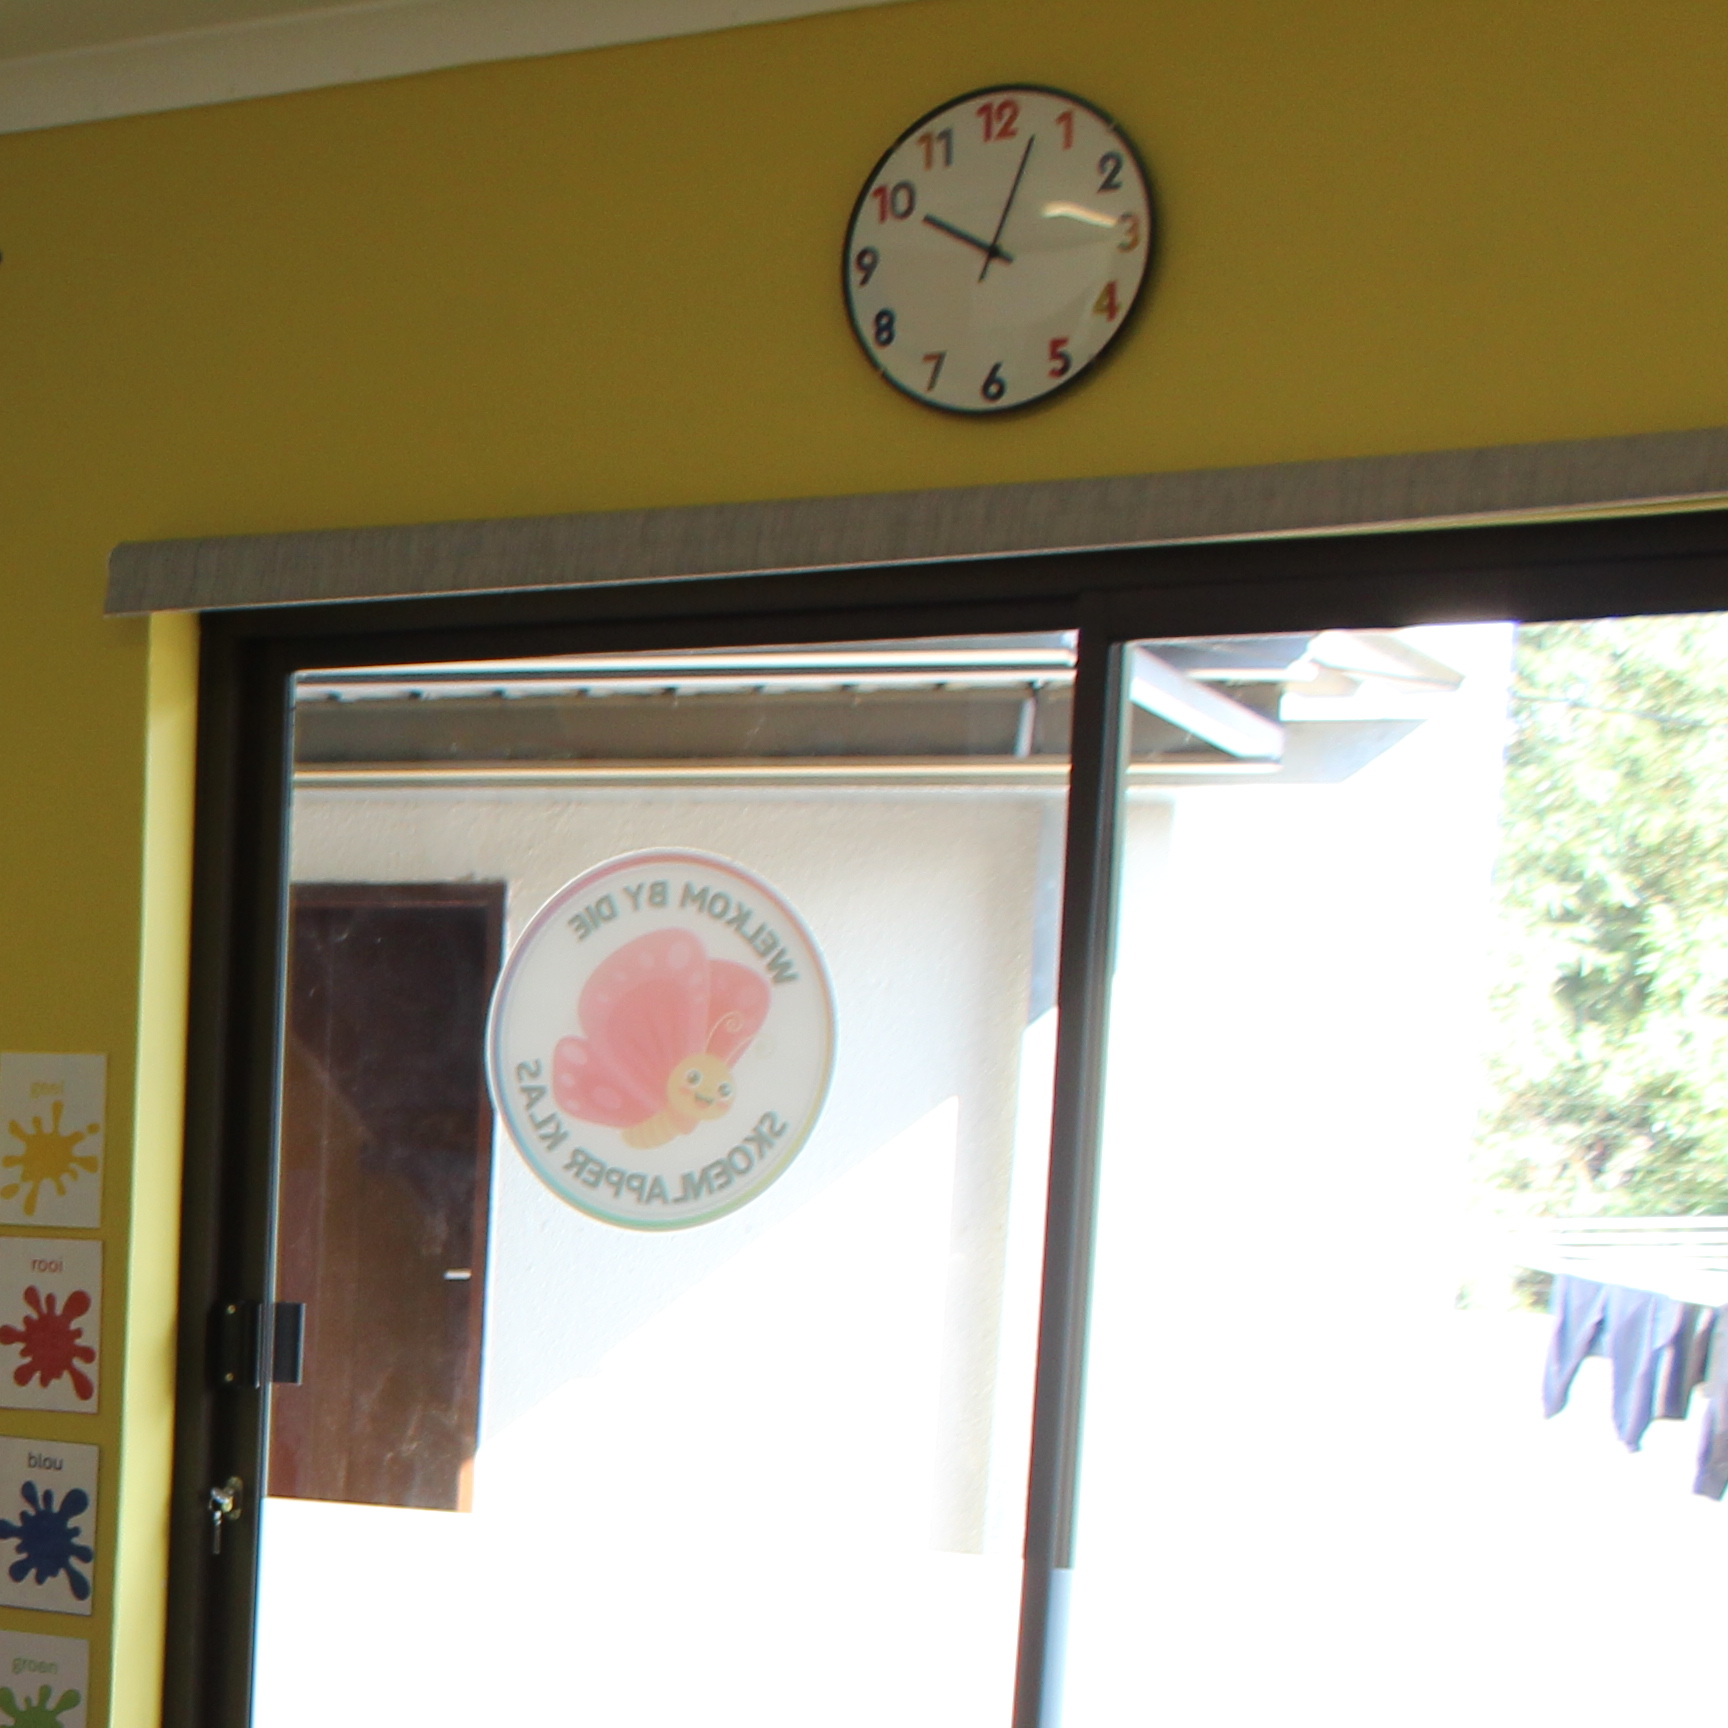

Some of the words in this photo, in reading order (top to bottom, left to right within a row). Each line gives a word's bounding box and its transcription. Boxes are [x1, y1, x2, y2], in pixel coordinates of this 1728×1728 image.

[976, 99, 1020, 143] 12
[1055, 111, 1075, 150] 1
[916, 127, 954, 171] 11
[1097, 151, 1123, 193] 2
[872, 180, 916, 224] 10
[1117, 211, 1140, 252] 3
[854, 246, 879, 287] 9
[1092, 280, 1120, 322] 4
[874, 308, 895, 347] 8
[922, 352, 947, 391] 7
[1048, 337, 1072, 379] 5
[981, 362, 1006, 402] 6
[30, 1256, 63, 1274] rooi
[27, 1451, 64, 1471] blou
[12, 1655, 59, 1676] groen
